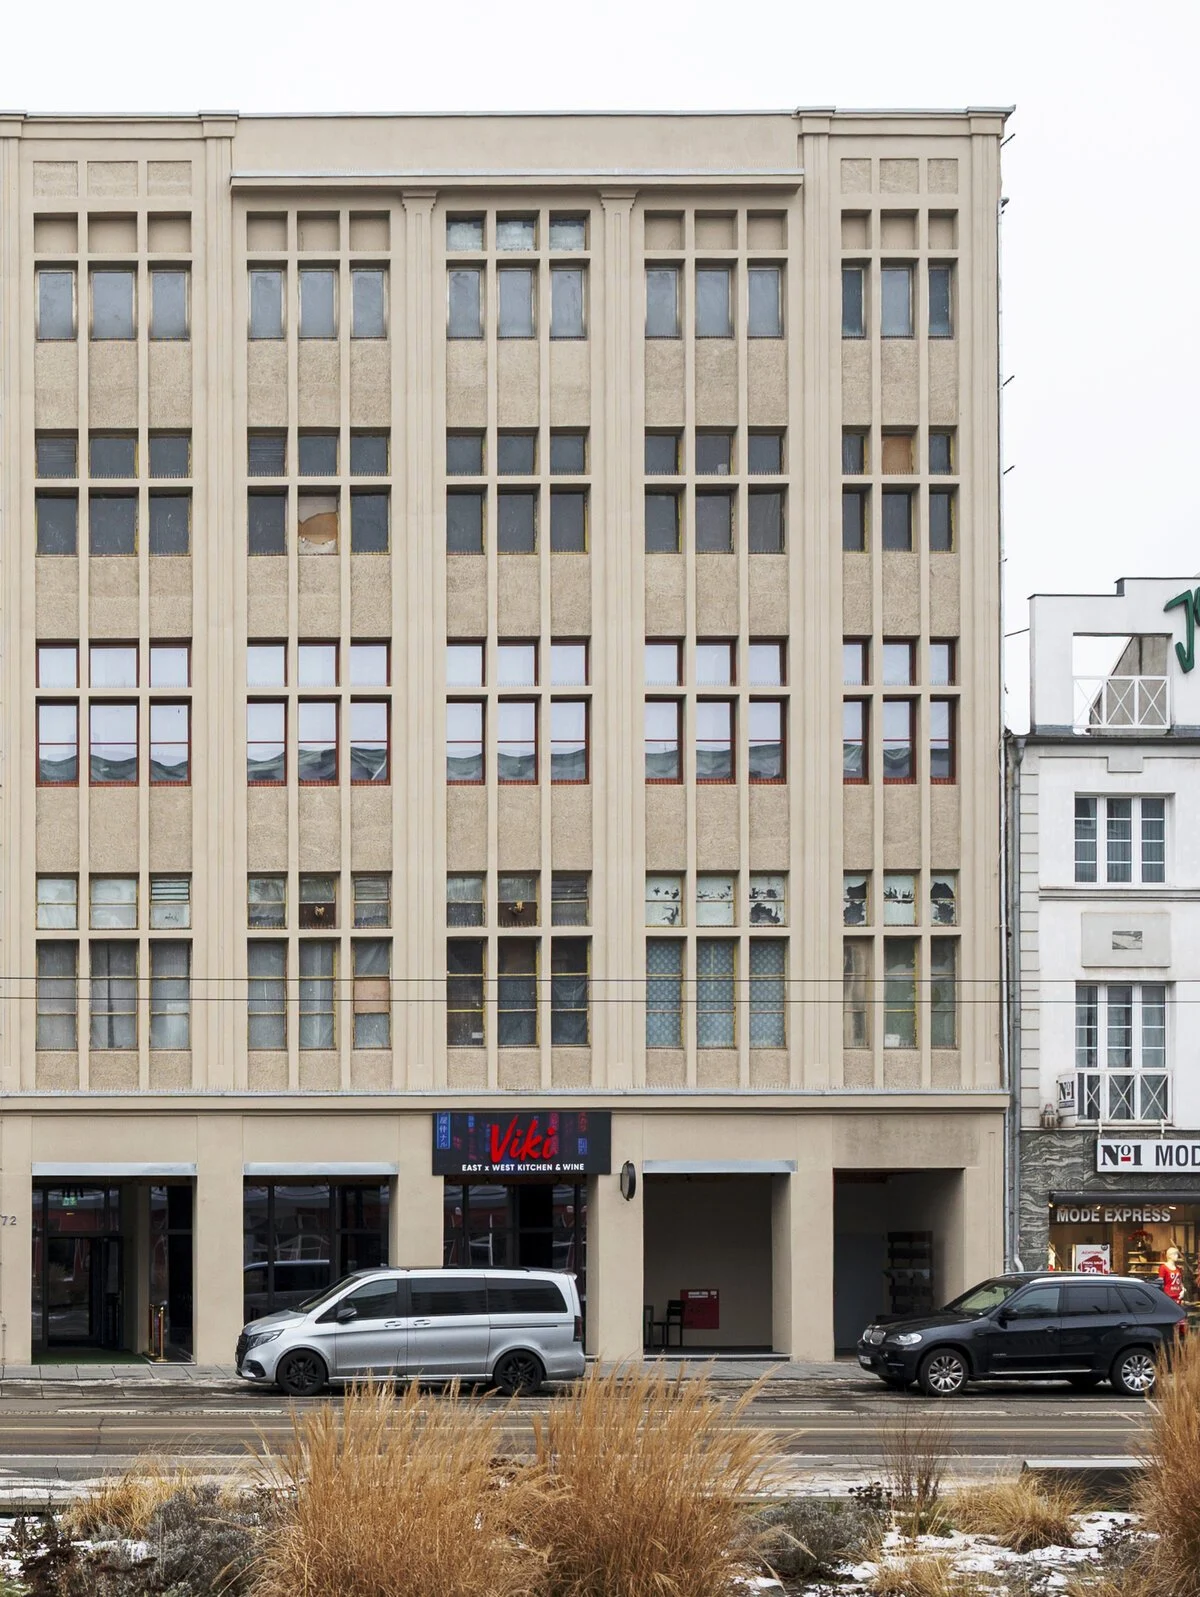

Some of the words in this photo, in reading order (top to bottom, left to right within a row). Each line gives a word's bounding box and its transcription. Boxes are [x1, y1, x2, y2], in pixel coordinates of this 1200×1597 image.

[489, 1114, 556, 1163] Viki
[462, 1164, 482, 1172] EAST
[492, 1164, 514, 1172] WEST
[517, 1163, 553, 1171] KITCHEN
[555, 1163, 561, 1171] &
[563, 1163, 585, 1171] WINE
[1, 1215, 17, 1226] 72
[1056, 1208, 1100, 1222] MODE
[1104, 1208, 1171, 1222] EXPRESS
